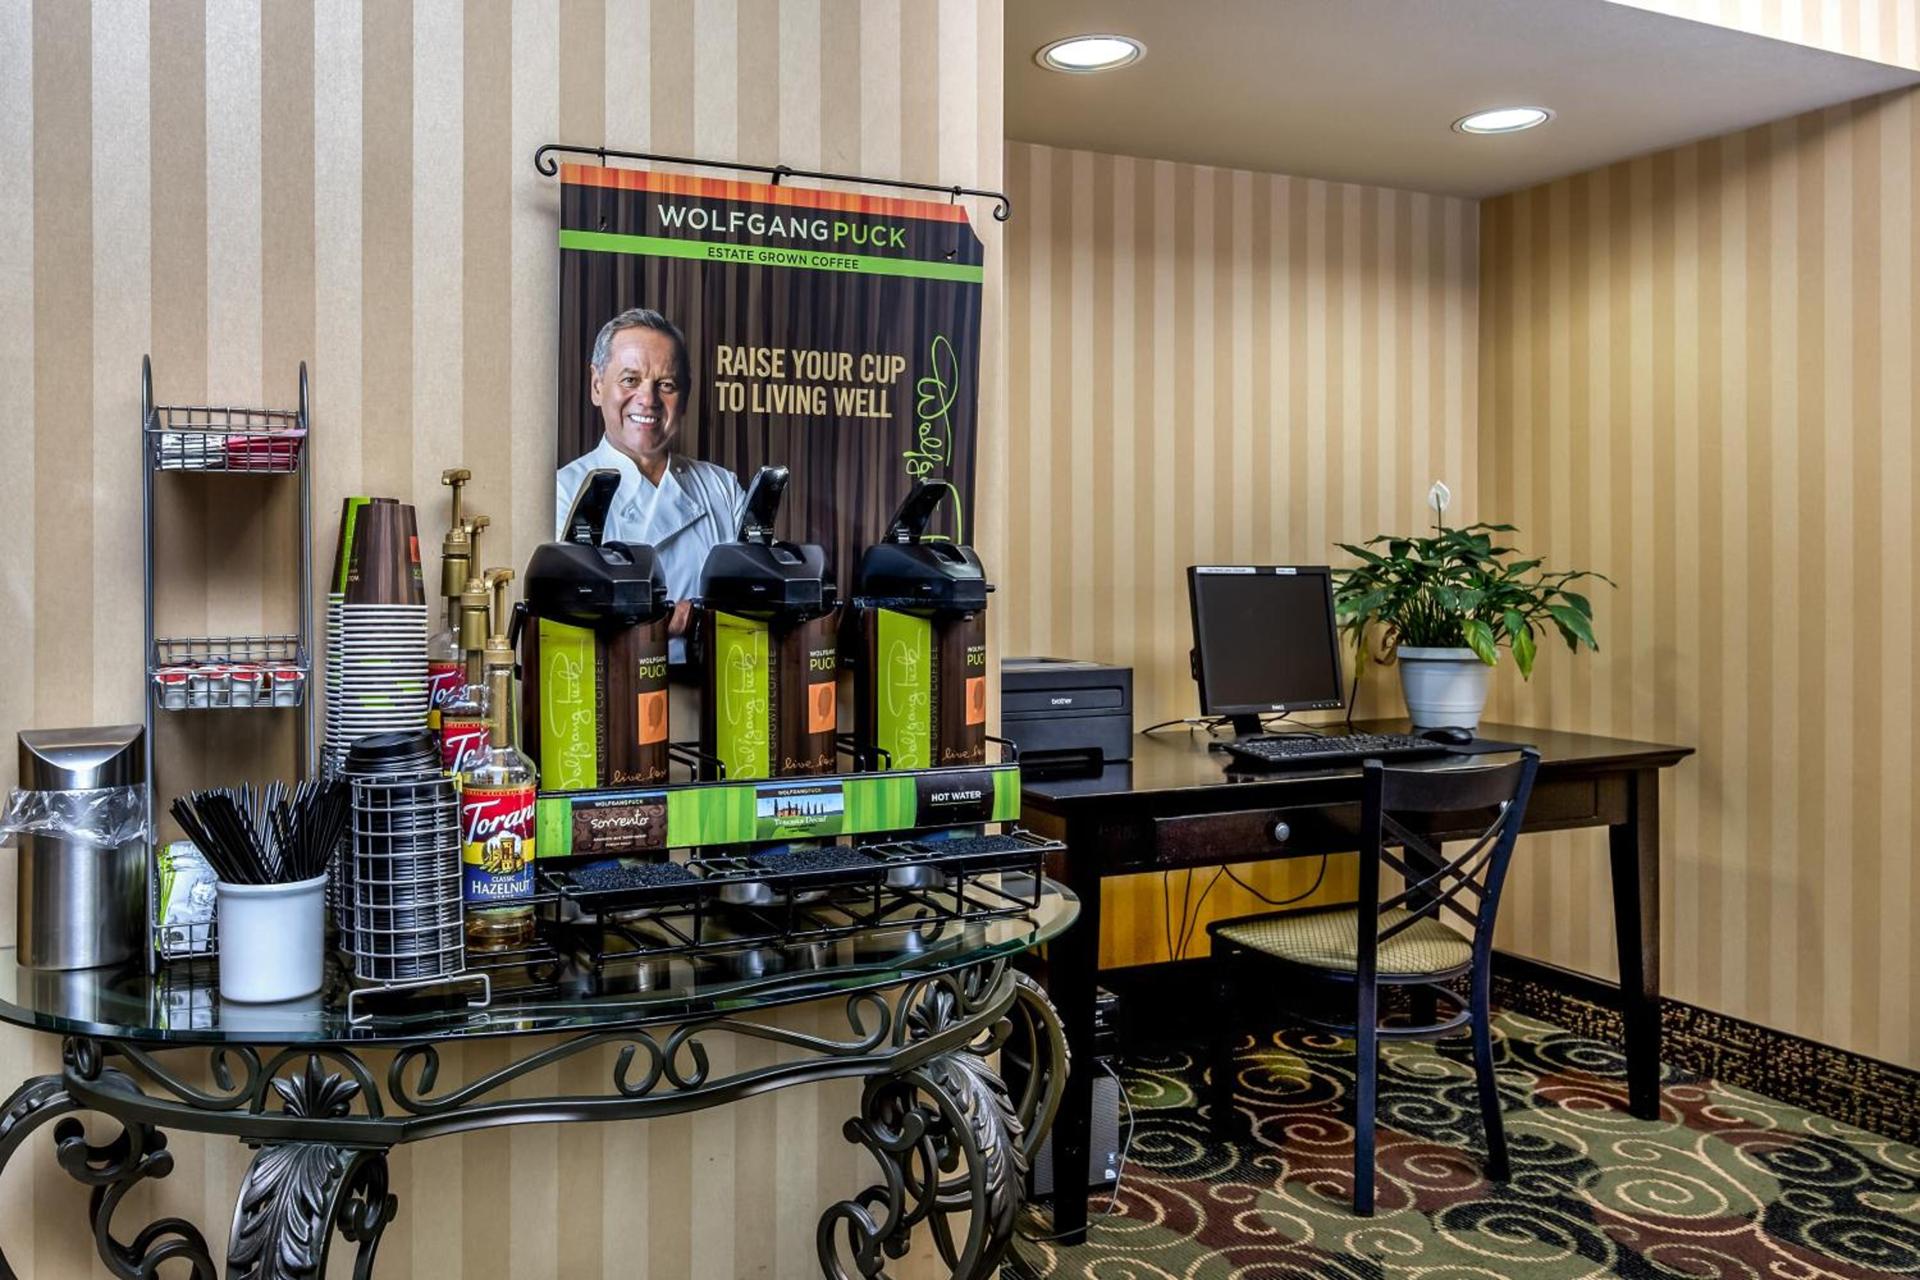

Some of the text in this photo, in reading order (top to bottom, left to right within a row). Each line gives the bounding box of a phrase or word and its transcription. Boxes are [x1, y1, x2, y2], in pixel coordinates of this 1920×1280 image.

[708, 246, 860, 270] ESTATE GROWN COFFEE
[717, 345, 906, 384] RAISE YOUR CUP
[715, 381, 893, 418] TO LIVING WELL
[967, 653, 985, 667] PUC
[931, 790, 982, 802] HOT WATER
[472, 879, 530, 896] HAZELNUT
